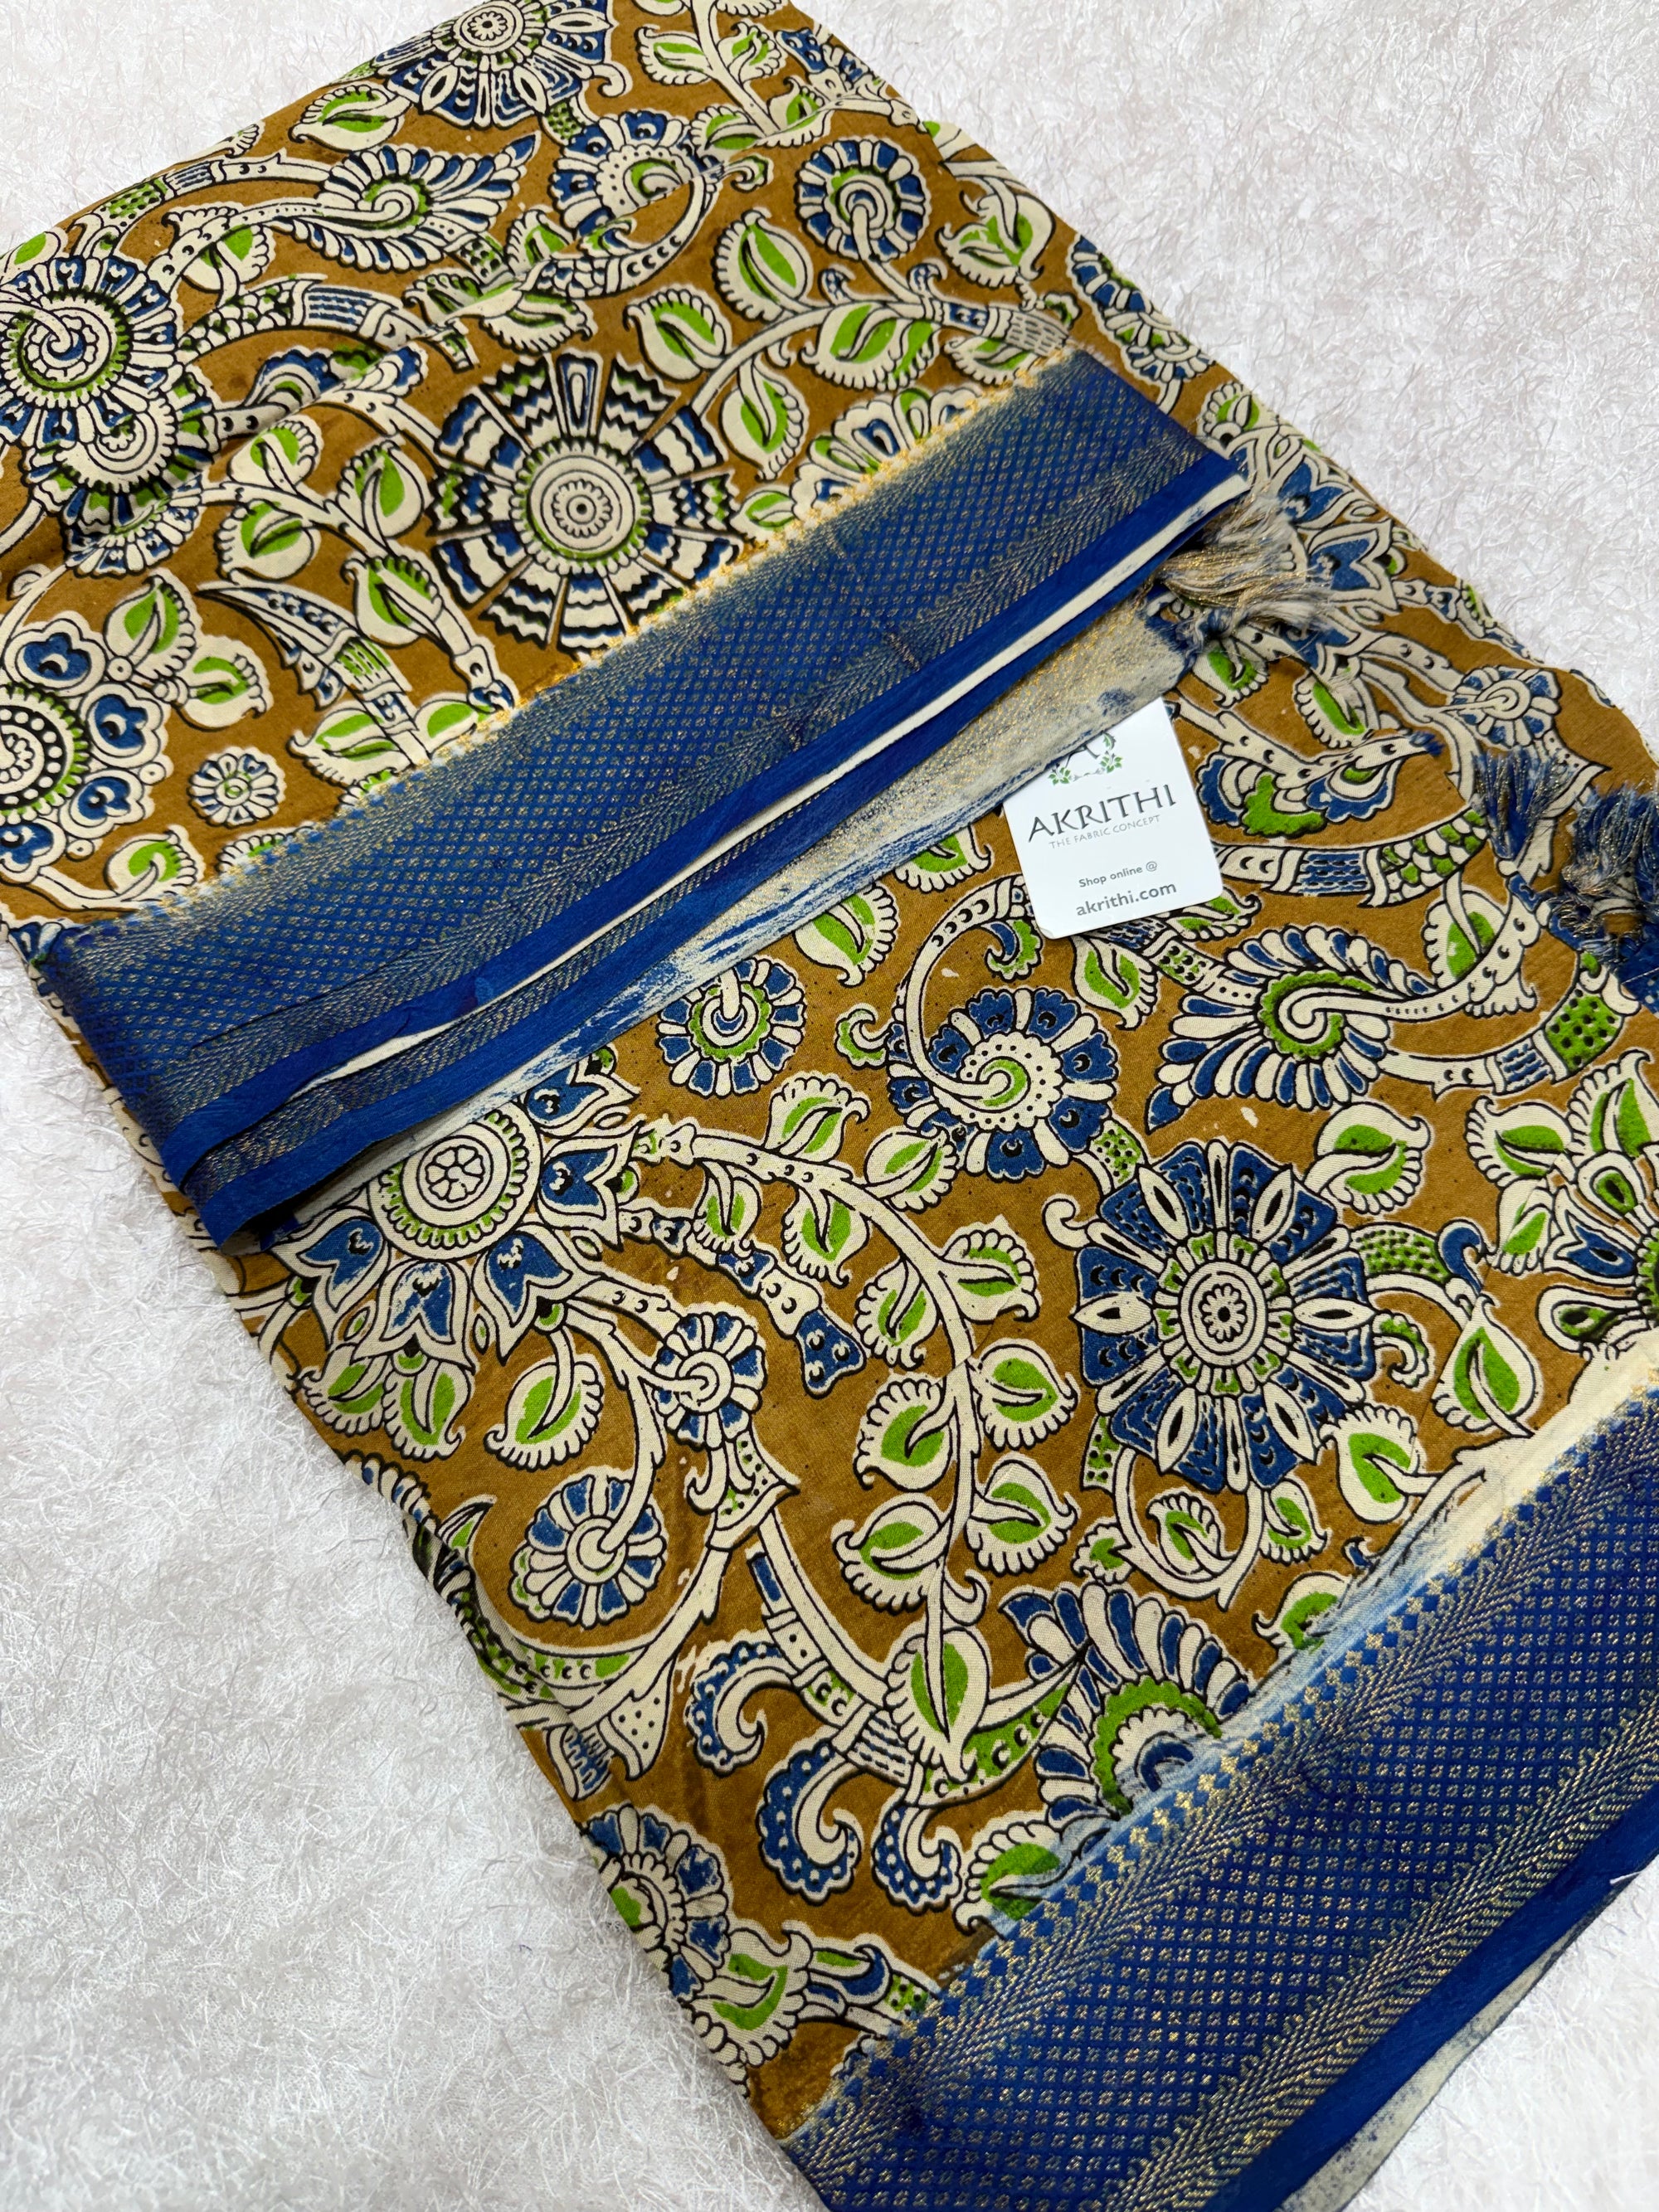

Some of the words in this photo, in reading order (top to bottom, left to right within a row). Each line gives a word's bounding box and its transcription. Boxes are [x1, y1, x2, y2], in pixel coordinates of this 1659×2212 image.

[1028, 784, 1177, 843] AKRITHI
[1048, 836, 1072, 849] THE
[1073, 827, 1111, 843] FABRIC
[1112, 814, 1161, 834] CONCEPT
[1078, 873, 1107, 888] Shop
[1109, 865, 1143, 881] online
[1146, 861, 1158, 873] @
[1076, 882, 1177, 916] akrithi.com
